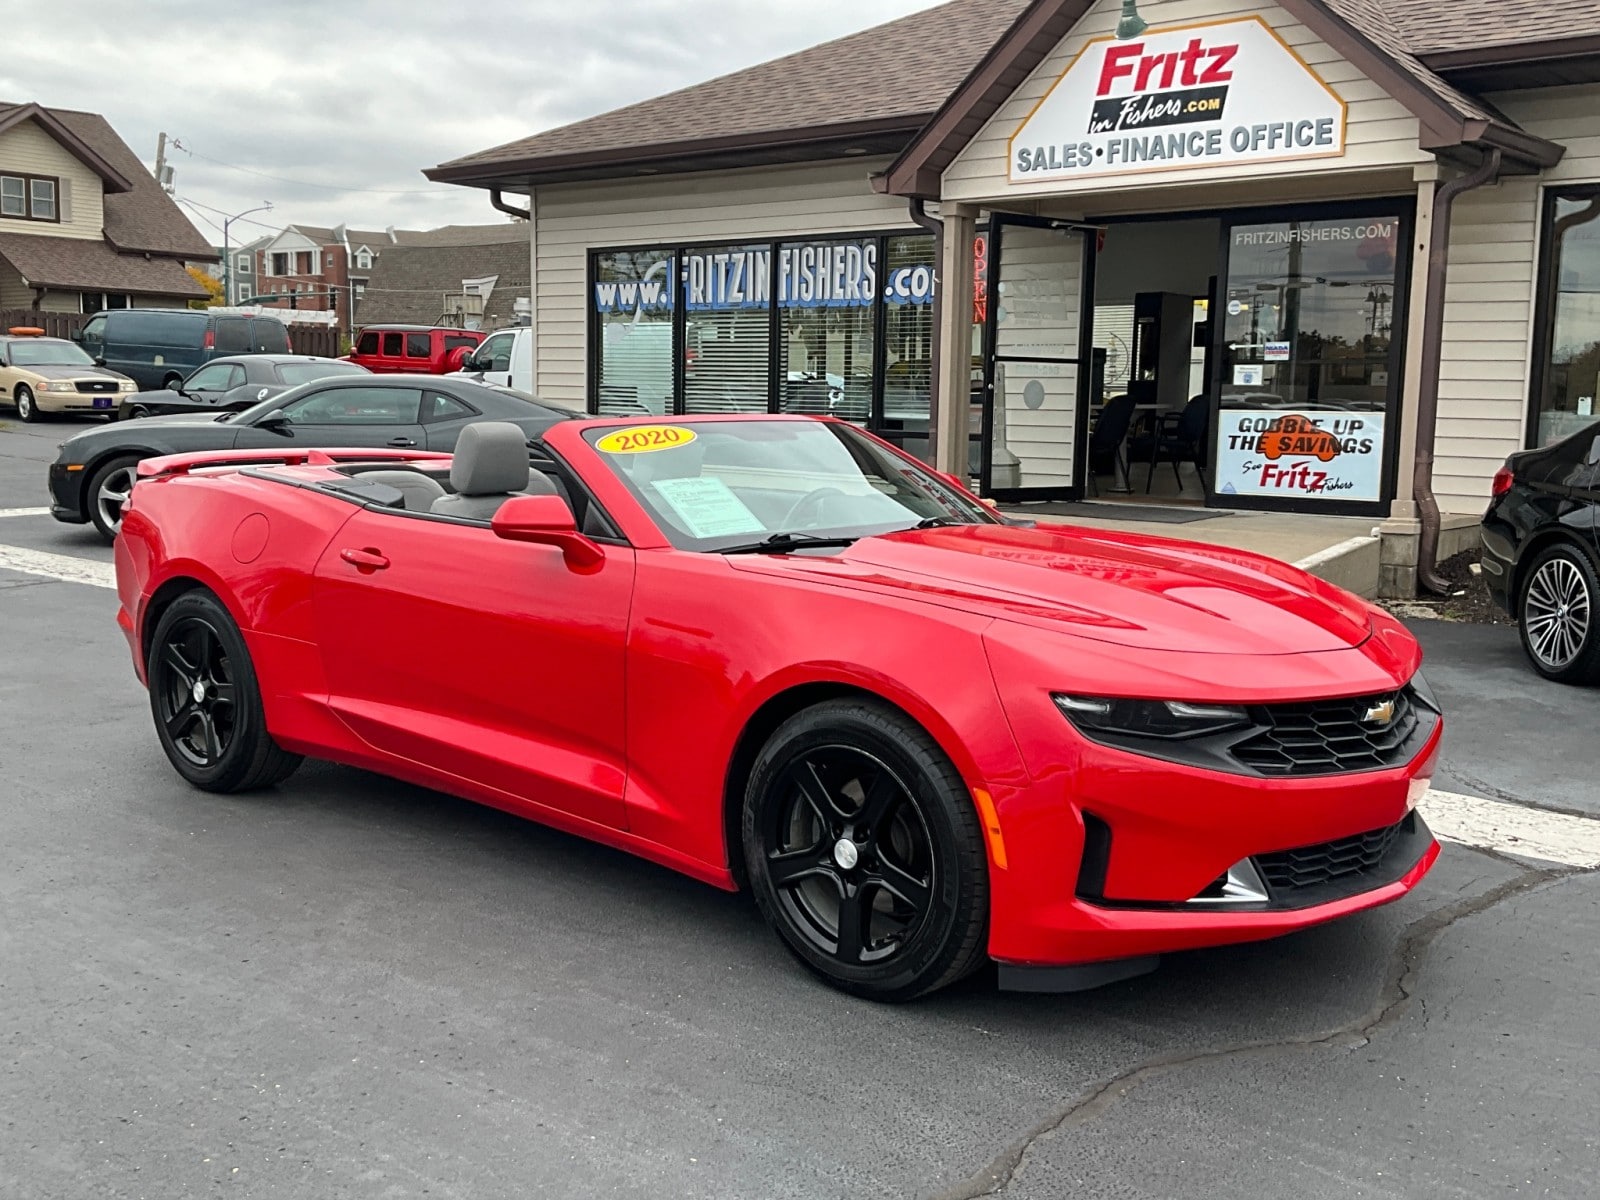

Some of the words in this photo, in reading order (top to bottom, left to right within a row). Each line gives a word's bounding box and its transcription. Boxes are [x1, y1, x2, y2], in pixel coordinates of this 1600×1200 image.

[1096, 38, 1239, 96] Fritz
[1090, 113, 1113, 134] in
[1017, 141, 1093, 172] SALES
[1106, 130, 1222, 164] FINANCE
[1230, 117, 1334, 152] OFFICE
[1236, 224, 1391, 245] FRITZINFISHERS.COM
[974, 237, 987, 323] OPEN
[1239, 417, 1324, 434] GOBBLE
[1333, 419, 1364, 435] UP
[615, 428, 680, 451] 2020
[1228, 435, 1269, 451] THE
[1278, 436, 1374, 454] SAVINGS
[1242, 461, 1262, 474] See
[1259, 461, 1327, 490] Fritz
[1320, 477, 1354, 494] Fishers
